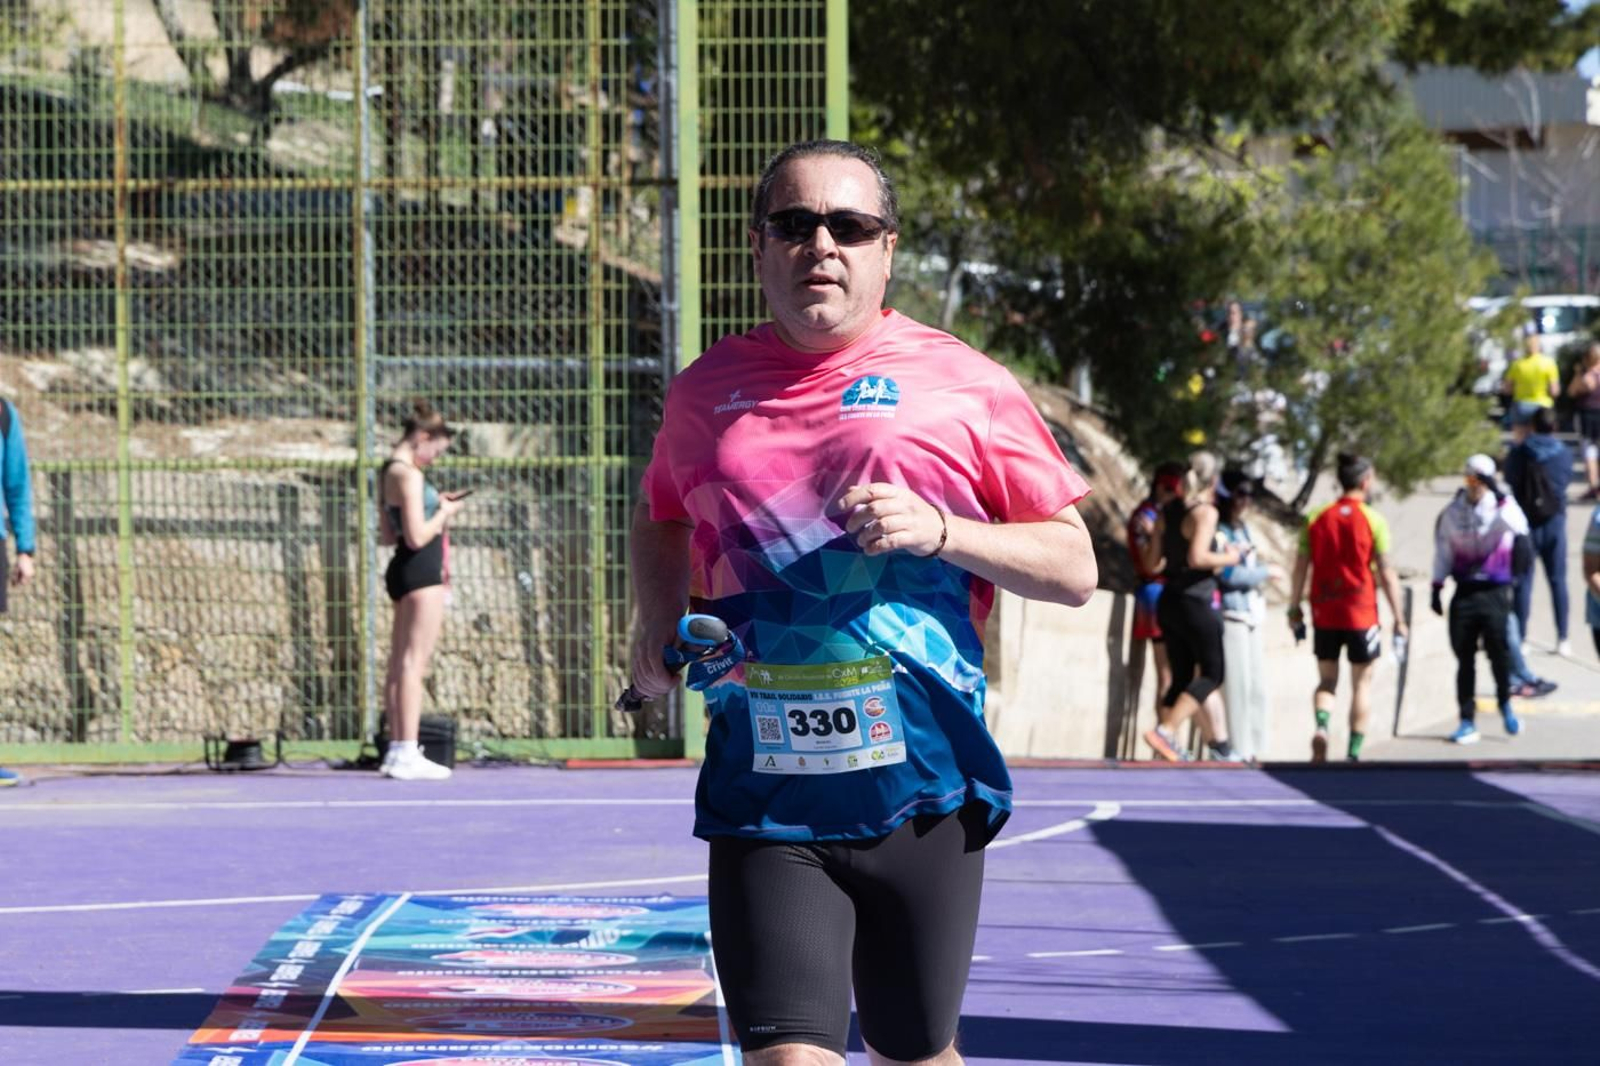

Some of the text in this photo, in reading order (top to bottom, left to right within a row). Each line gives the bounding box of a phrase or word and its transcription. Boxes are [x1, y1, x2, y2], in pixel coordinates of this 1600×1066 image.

[760, 691, 777, 699] TRAIL
[778, 692, 813, 700] SOLIDARIO
[861, 685, 872, 695] LA
[787, 706, 857, 737] 330
